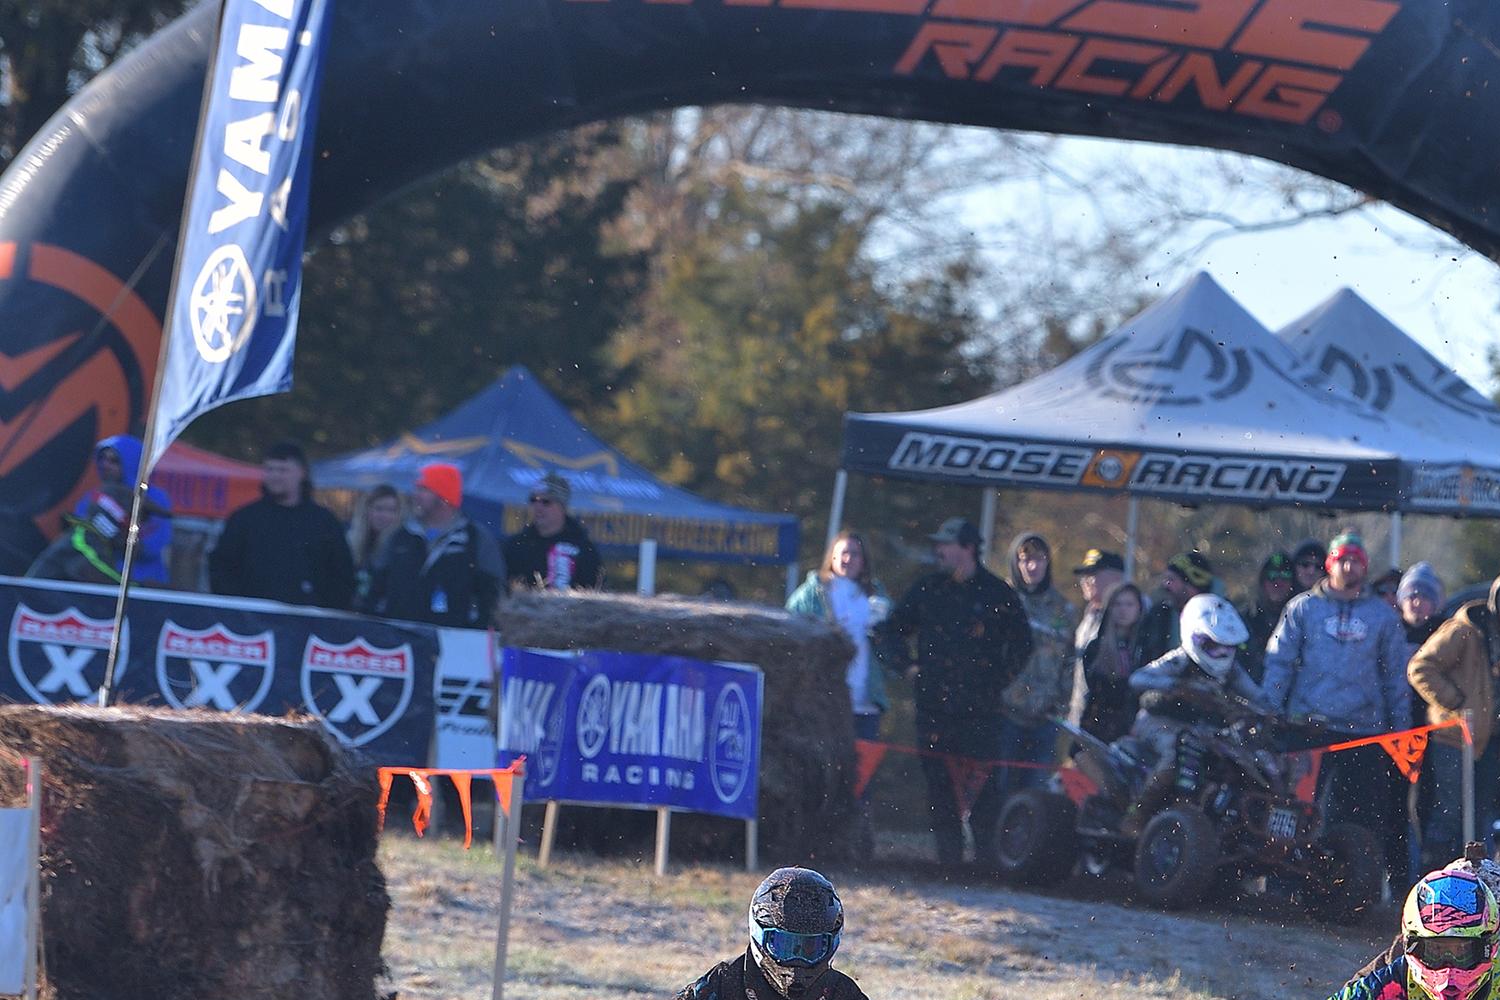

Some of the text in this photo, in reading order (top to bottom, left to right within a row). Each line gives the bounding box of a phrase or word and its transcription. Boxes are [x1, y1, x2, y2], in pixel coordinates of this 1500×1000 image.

[893, 20, 1344, 125] RACING
[890, 432, 1346, 500] MOOSE RACING
[36, 644, 97, 697] X
[168, 637, 262, 659] RACER
[313, 651, 402, 672] RACER
[183, 660, 241, 712] X
[327, 673, 383, 726] X
